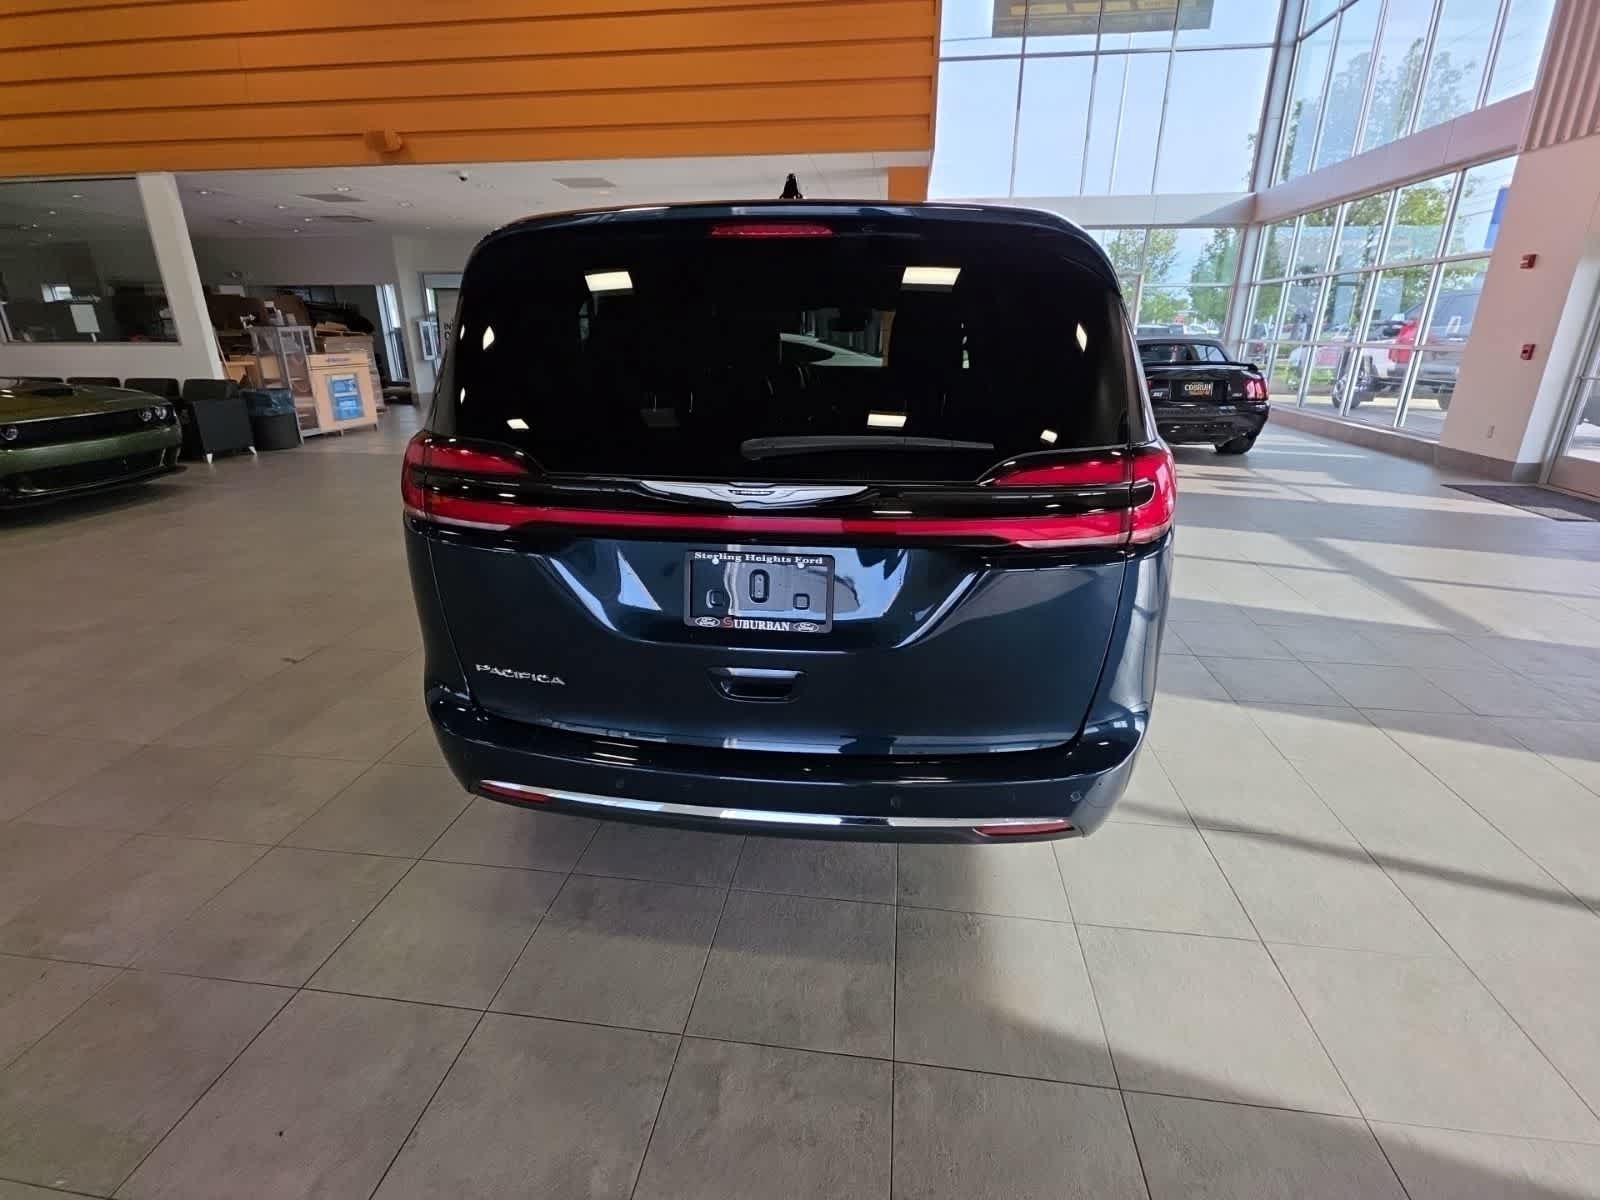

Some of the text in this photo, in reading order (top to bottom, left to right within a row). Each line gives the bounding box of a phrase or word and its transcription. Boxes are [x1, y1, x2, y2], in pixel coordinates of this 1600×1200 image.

[694, 551, 823, 565] Sterling Heights Ford
[723, 617, 790, 631] SUBURBAN
[475, 664, 566, 685] PACIFICA
